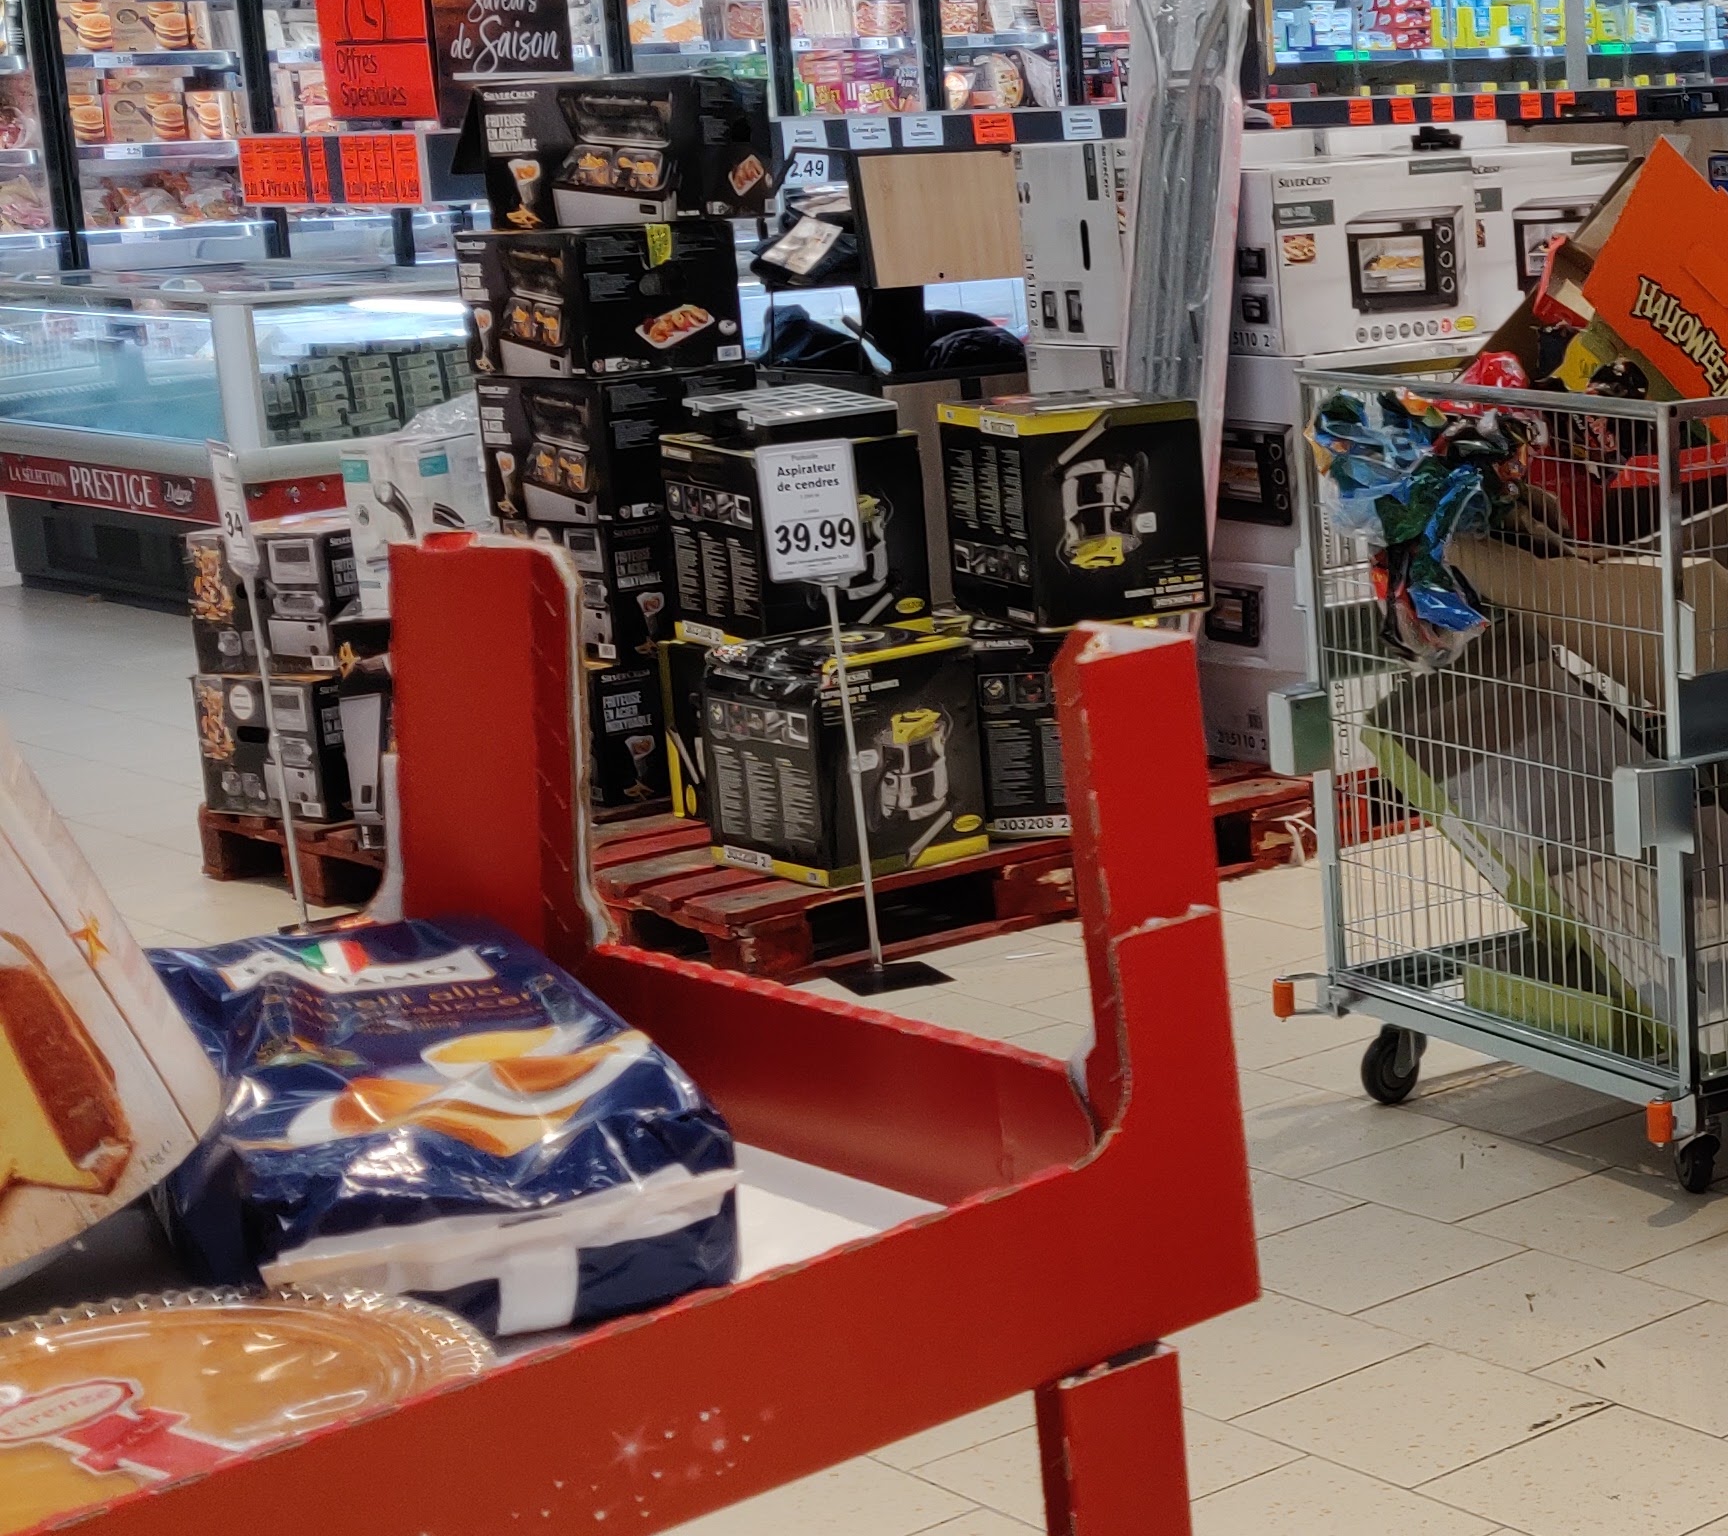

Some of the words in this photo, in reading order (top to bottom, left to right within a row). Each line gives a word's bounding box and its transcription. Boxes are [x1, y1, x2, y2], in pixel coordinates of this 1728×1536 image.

[450, 23, 474, 60] de
[473, 15, 560, 73] Saison
[336, 49, 377, 80] Offres
[789, 158, 825, 178] 2.49
[777, 463, 837, 478] Aspirateur
[777, 481, 791, 492] de
[795, 477, 840, 490] cendres
[8, 465, 22, 482] LA
[68, 465, 157, 509] PRESTIGE
[775, 518, 856, 555] 39.99
